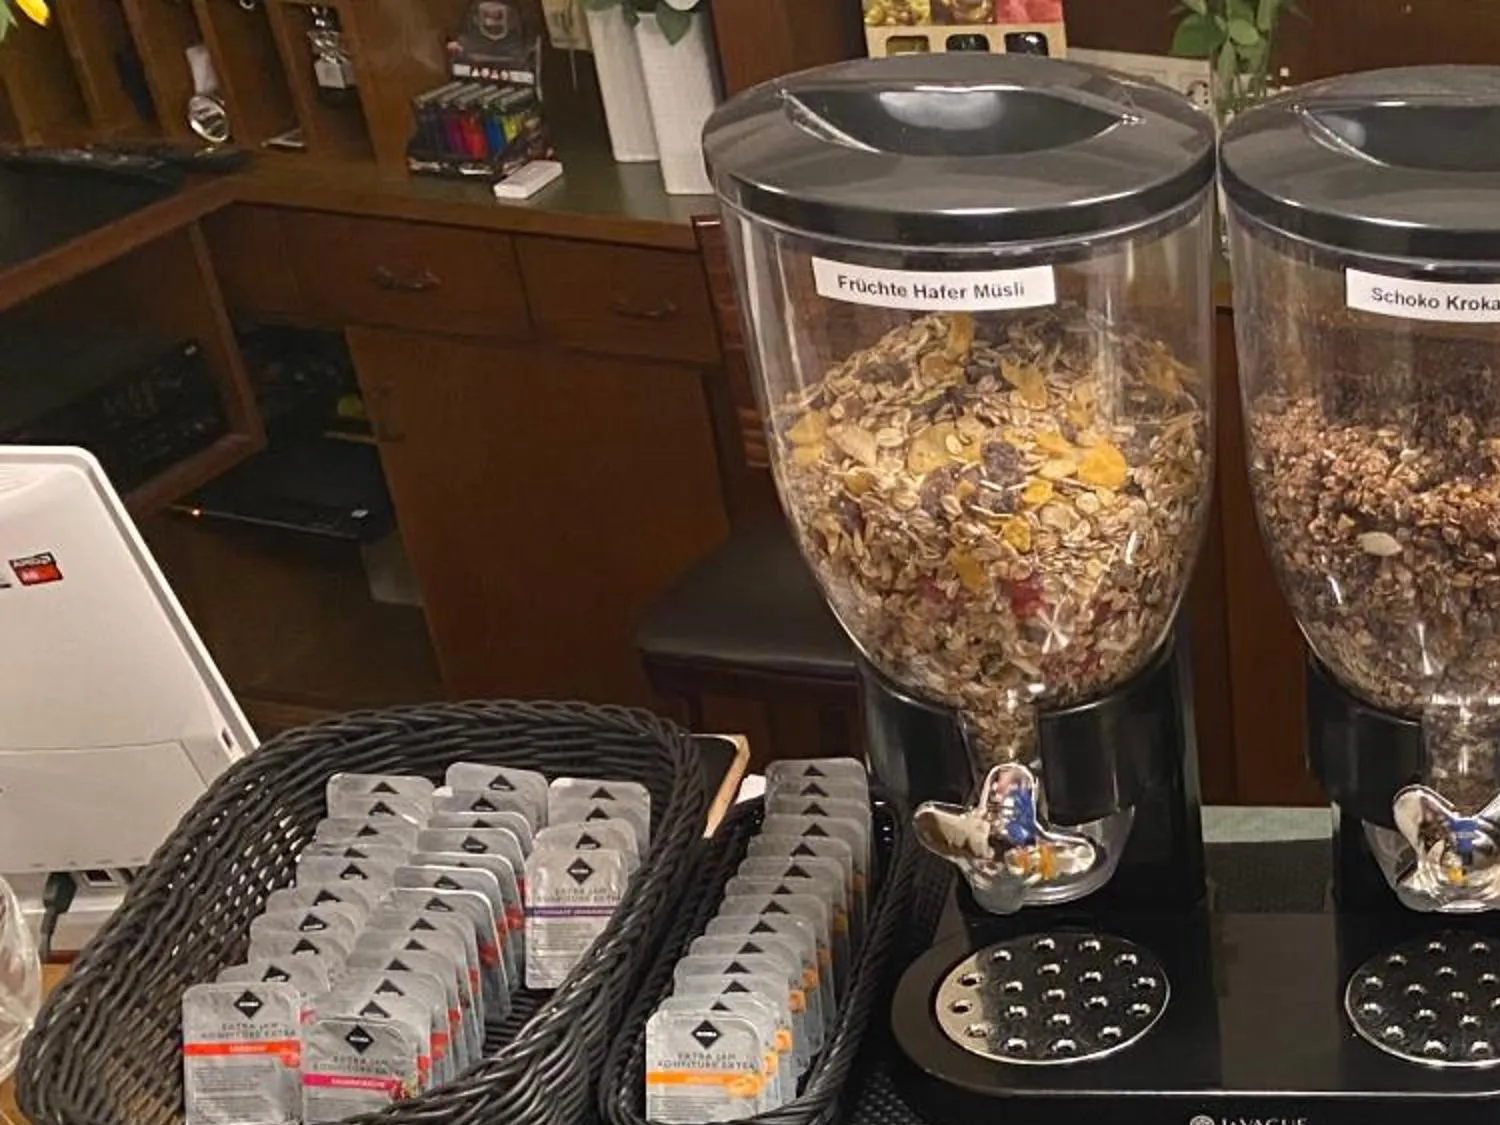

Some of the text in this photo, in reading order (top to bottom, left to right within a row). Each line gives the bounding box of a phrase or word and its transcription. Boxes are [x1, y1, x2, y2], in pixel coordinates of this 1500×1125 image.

[837, 274, 1025, 299] Früchte Hafer Müsli
[1371, 286, 1440, 310] Schoko
